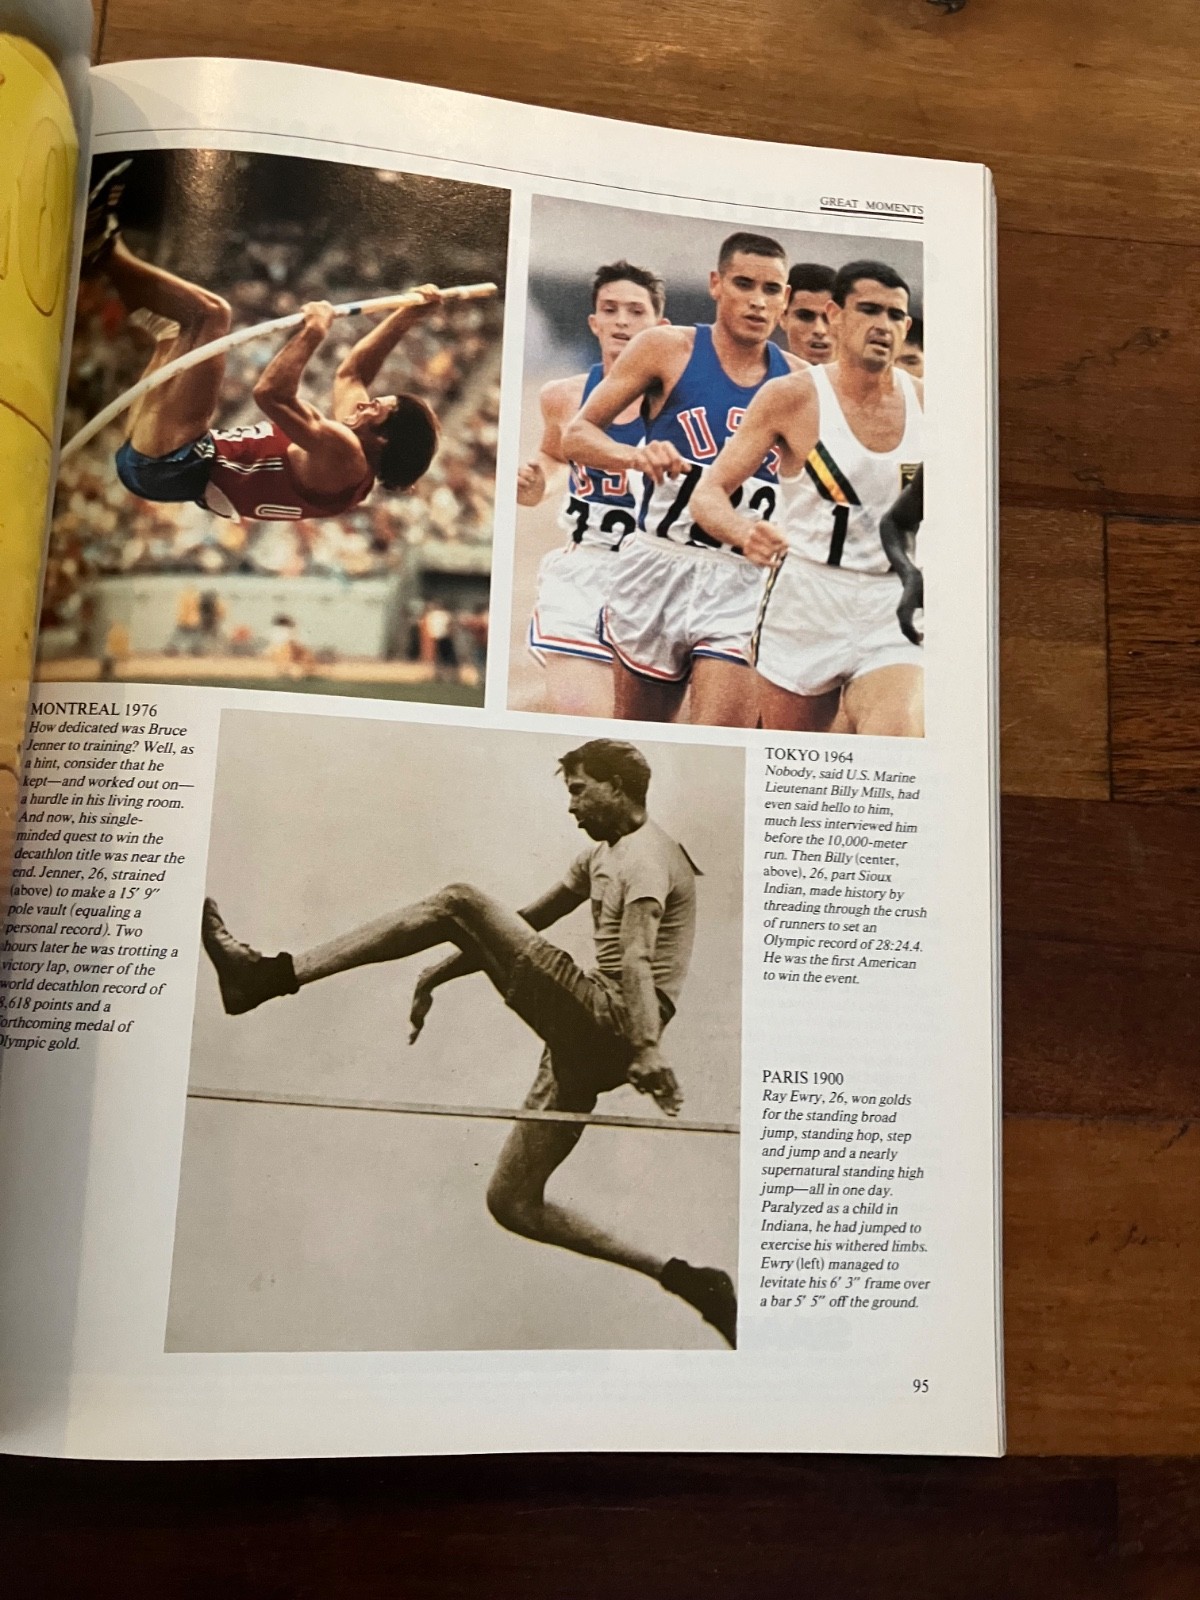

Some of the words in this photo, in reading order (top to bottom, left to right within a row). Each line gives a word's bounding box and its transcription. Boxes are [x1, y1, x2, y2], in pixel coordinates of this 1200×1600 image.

[820, 196, 858, 208] GREAT
[866, 200, 924, 214] MOMENTS
[31, 702, 120, 715] MONTREAL
[126, 703, 157, 717] 1976
[28, 721, 56, 733] How
[58, 721, 119, 733] dedicated
[122, 725, 145, 734] was
[147, 722, 187, 736] Bruce
[26, 738, 66, 751] Jenner
[68, 741, 80, 750] to
[83, 739, 139, 754] training?
[144, 740, 176, 755] Well,
[180, 745, 195, 754] as
[765, 747, 820, 761] TOKYO
[825, 750, 853, 763] 1964
[24, 760, 31, 768] a
[34, 756, 60, 770] hint,
[64, 757, 118, 769] consider
[120, 758, 145, 770] that
[147, 759, 164, 771] he
[765, 764, 816, 780] Nobody,
[819, 768, 844, 779] said
[846, 769, 870, 781] U.S.
[873, 770, 916, 783] Marine
[765, 781, 828, 795] Lieutenant
[830, 784, 859, 798] Billy
[861, 786, 894, 800] Mills,
[897, 788, 920, 799] had
[20, 796, 27, 804] a
[30, 793, 69, 804] hurdle
[71, 793, 83, 805] in
[86, 793, 105, 806] his
[108, 794, 144, 809] living
[146, 798, 184, 808] room.
[764, 801, 791, 810] even
[794, 800, 819, 811] said
[820, 801, 851, 813] hello
[853, 804, 865, 814] to
[867, 803, 894, 817] him,
[18, 811, 45, 822] And
[46, 814, 75, 824] now,
[78, 811, 98, 824] his
[100, 812, 143, 827] single-
[764, 816, 797, 827] much
[799, 816, 822, 828] less
[824, 817, 893, 832] interviewed
[895, 821, 917, 833] him
[16, 829, 62, 841] minded
[63, 832, 97, 844] quest
[100, 832, 113, 842] to
[116, 831, 139, 843] win
[142, 832, 164, 845] the
[764, 831, 803, 844] before
[806, 833, 824, 845] the
[828, 835, 908, 849] 10,000-meter
[14, 847, 73, 860] decathlon
[76, 848, 101, 861] title
[104, 852, 128, 861] was
[130, 853, 162, 863] near
[163, 851, 185, 864] the
[13, 866, 36, 877] end.
[39, 865, 84, 880] Jenner,
[88, 867, 107, 881] 26,
[111, 869, 166, 881] strained
[763, 865, 806, 879] above),
[809, 867, 828, 881] 26,
[830, 871, 856, 882] part
[858, 869, 891, 882] Sioux
[763, 882, 806, 897] Indian,
[809, 885, 842, 897] made
[844, 886, 887, 901] history
[889, 888, 904, 902] by
[8, 902, 34, 916] pole
[37, 903, 67, 916] vault
[70, 903, 131, 920] (equaling
[133, 909, 141, 918] a
[764, 899, 821, 915] threading
[824, 902, 870, 917] through
[873, 905, 892, 916] the
[894, 907, 927, 918] crush
[5, 922, 58, 935] personal
[60, 922, 111, 937] record).
[116, 924, 143, 937] Two
[764, 933, 816, 949] Olympic
[818, 938, 858, 949] record
[860, 938, 875, 950] of
[875, 939, 922, 952] 28:24.4.
[3, 958, 44, 974] victory
[46, 959, 69, 975] lap,
[73, 963, 115, 974] owner
[116, 962, 134, 975] of
[134, 963, 156, 976] the
[763, 951, 782, 963] He
[784, 955, 807, 964] was
[810, 953, 829, 965] the
[831, 954, 855, 966] first
[857, 956, 916, 969] American
[32, 997, 73, 1012] points
[76, 999, 101, 1012] and
[103, 1003, 111, 1012] a
[0, 1015, 72, 1032] orthcoming
[74, 1019, 115, 1032] medal
[117, 1020, 135, 1032] of
[47, 1037, 80, 1051] gold.
[763, 1070, 808, 1084] PARIS
[814, 1071, 843, 1085] 1900
[762, 1089, 788, 1104] Ray
[790, 1089, 825, 1105] Ewry,
[829, 1091, 848, 1105] 26,
[852, 1095, 876, 1104] won
[878, 1093, 911, 1107] golds
[762, 1107, 782, 1119] for
[784, 1108, 804, 1121] the
[806, 1110, 858, 1124] standing
[861, 1110, 897, 1123] broad
[760, 1126, 797, 1141] jump,
[801, 1128, 854, 1142] standing
[856, 1129, 883, 1143] hop,
[887, 1132, 912, 1144] step
[761, 1164, 840, 1178] supernatural
[842, 1165, 895, 1180] standing
[897, 1166, 924, 1180] high
[761, 1200, 824, 1215] Paralyzed
[826, 1205, 839, 1214] as
[842, 1205, 849, 1214] a
[852, 1202, 884, 1214] child
[886, 1203, 898, 1215] in
[761, 1218, 812, 1233] Indiana,
[816, 1220, 831, 1232] he
[833, 1220, 857, 1233] had
[858, 1220, 907, 1236] jumped
[910, 1224, 921, 1233] to
[761, 1238, 812, 1251] exercise
[814, 1239, 832, 1251] his
[835, 1239, 889, 1252] withered
[892, 1239, 927, 1252] limbs.
[760, 1256, 794, 1271] Ewry
[796, 1257, 824, 1271] (left)
[828, 1258, 885, 1272] managed
[887, 1261, 899, 1270] to
[913, 1379, 928, 1393] 95
